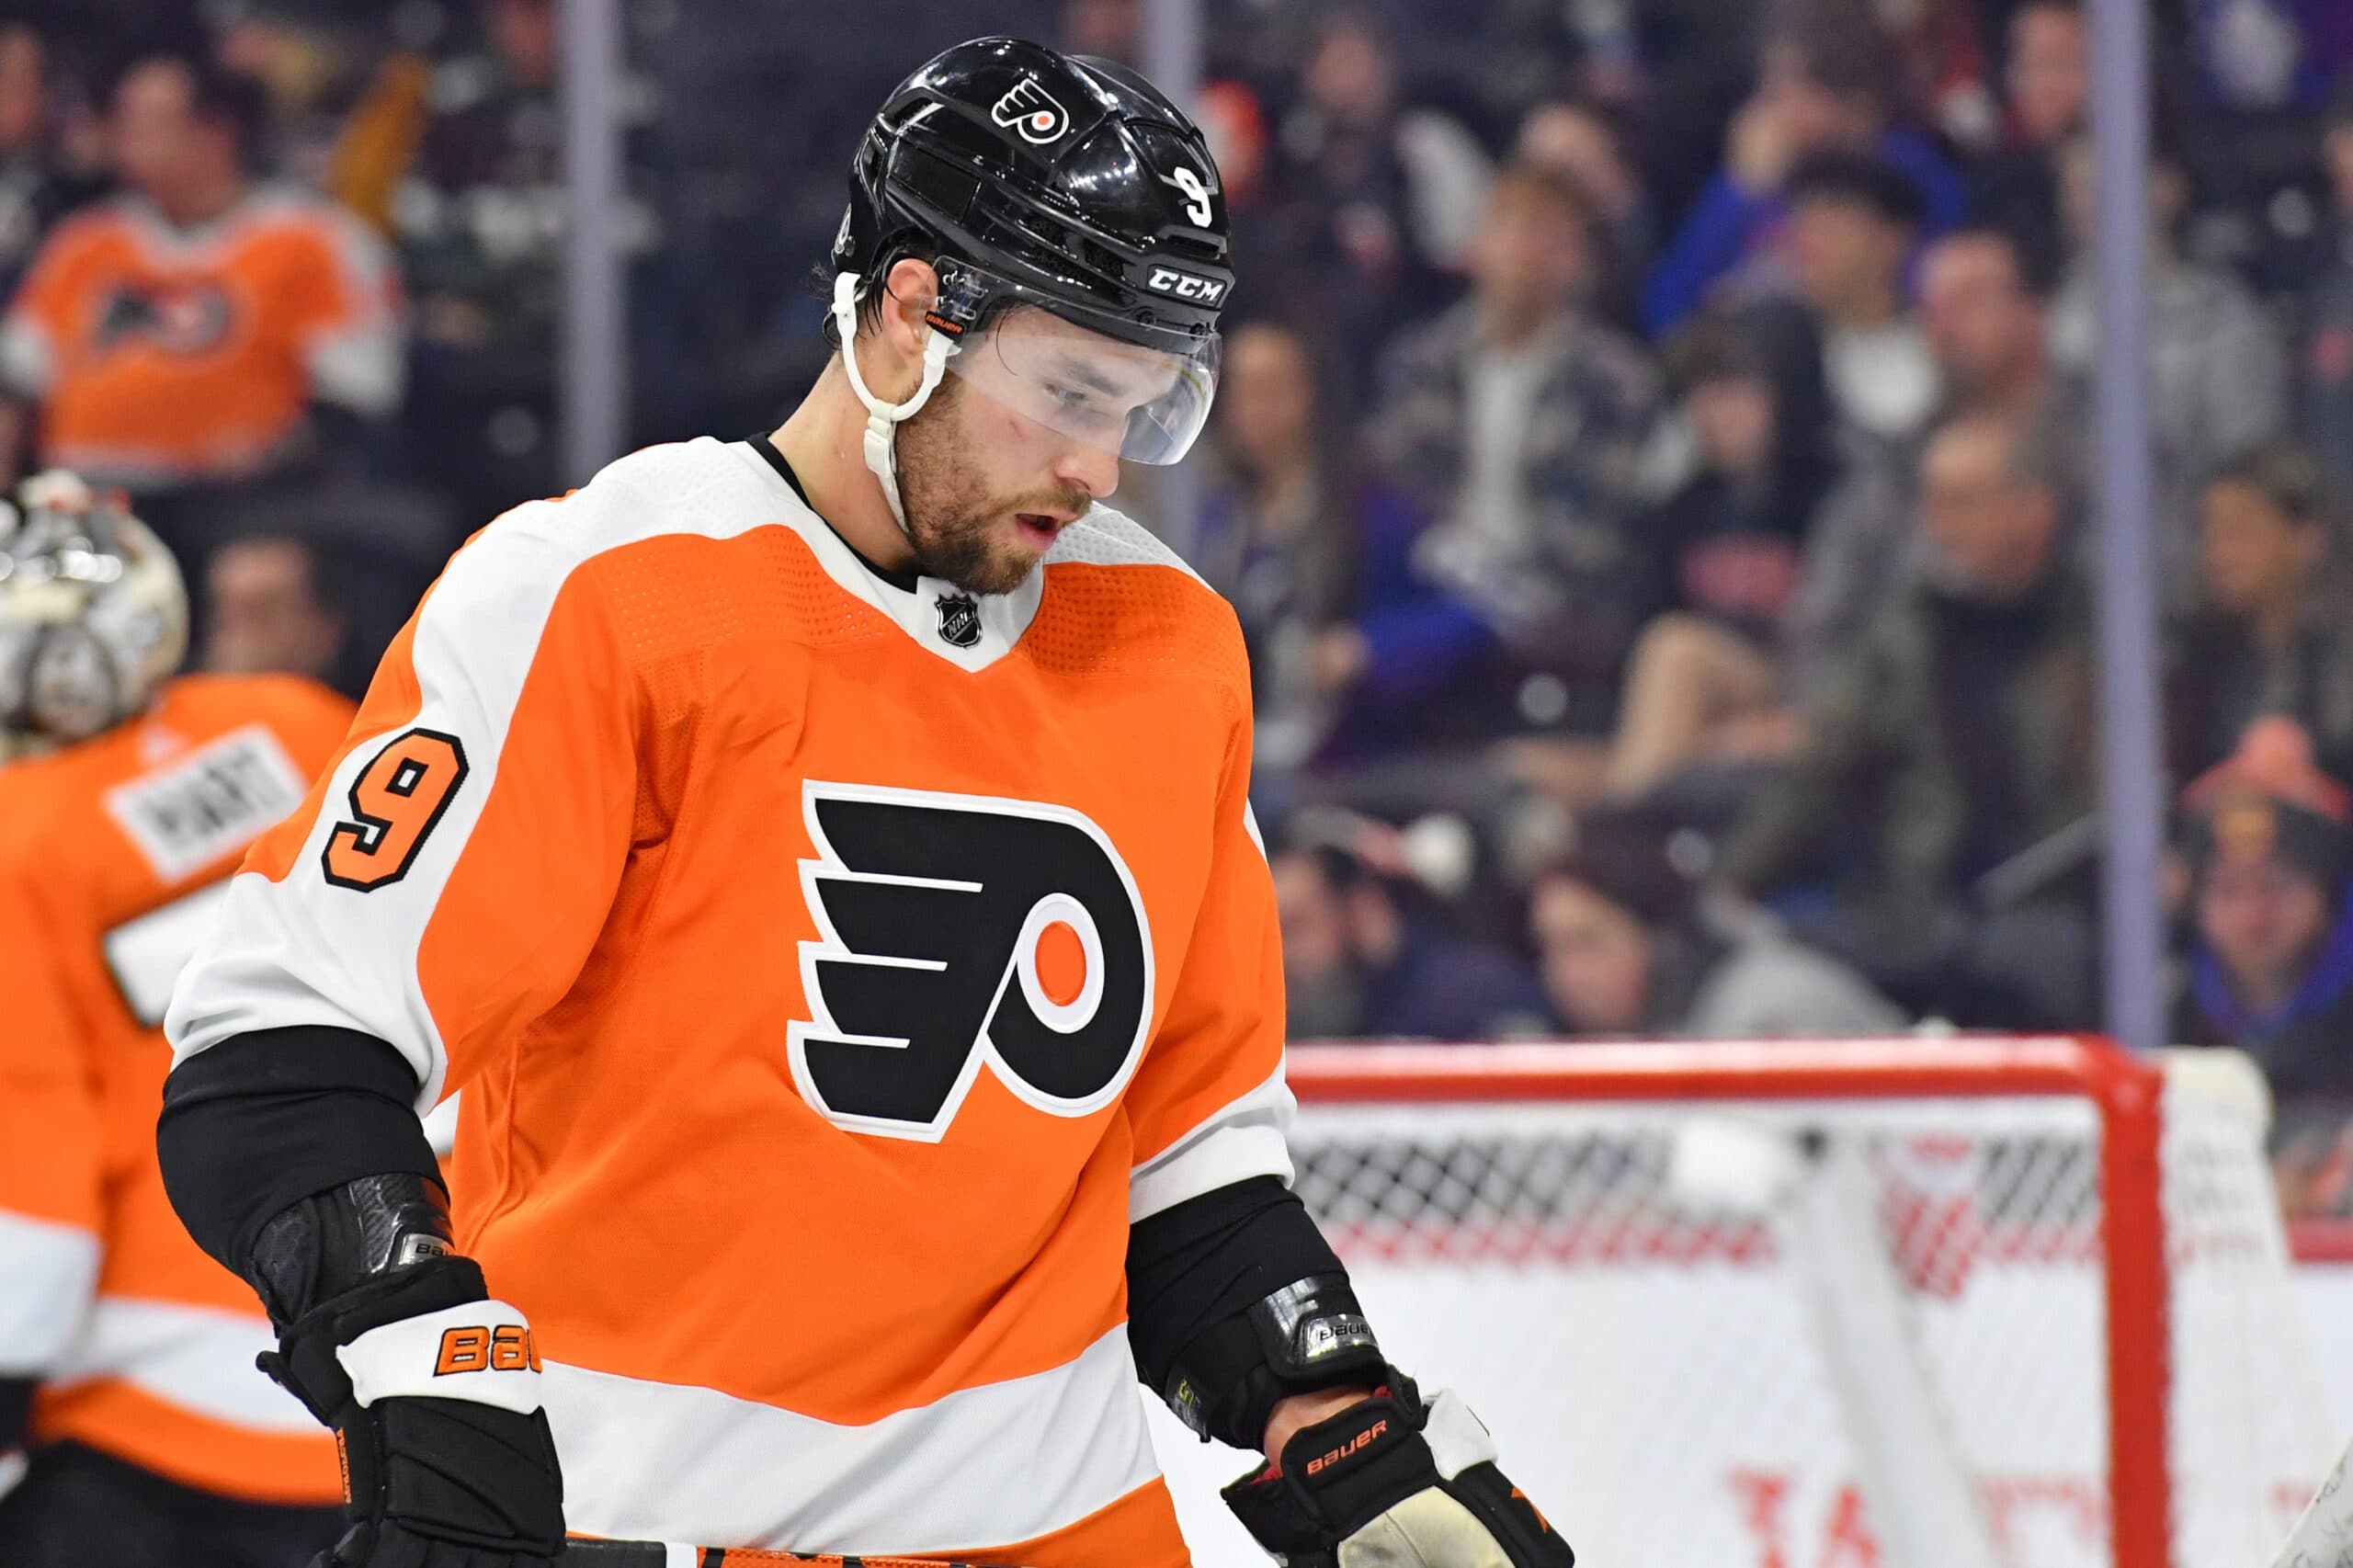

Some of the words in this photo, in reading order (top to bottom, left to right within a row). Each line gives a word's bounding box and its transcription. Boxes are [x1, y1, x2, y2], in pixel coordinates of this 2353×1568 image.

[1173, 165, 1213, 229] 9
[1148, 267, 1224, 301] CCM
[321, 727, 470, 893] 9
[1306, 1419, 1388, 1476] BAUER
